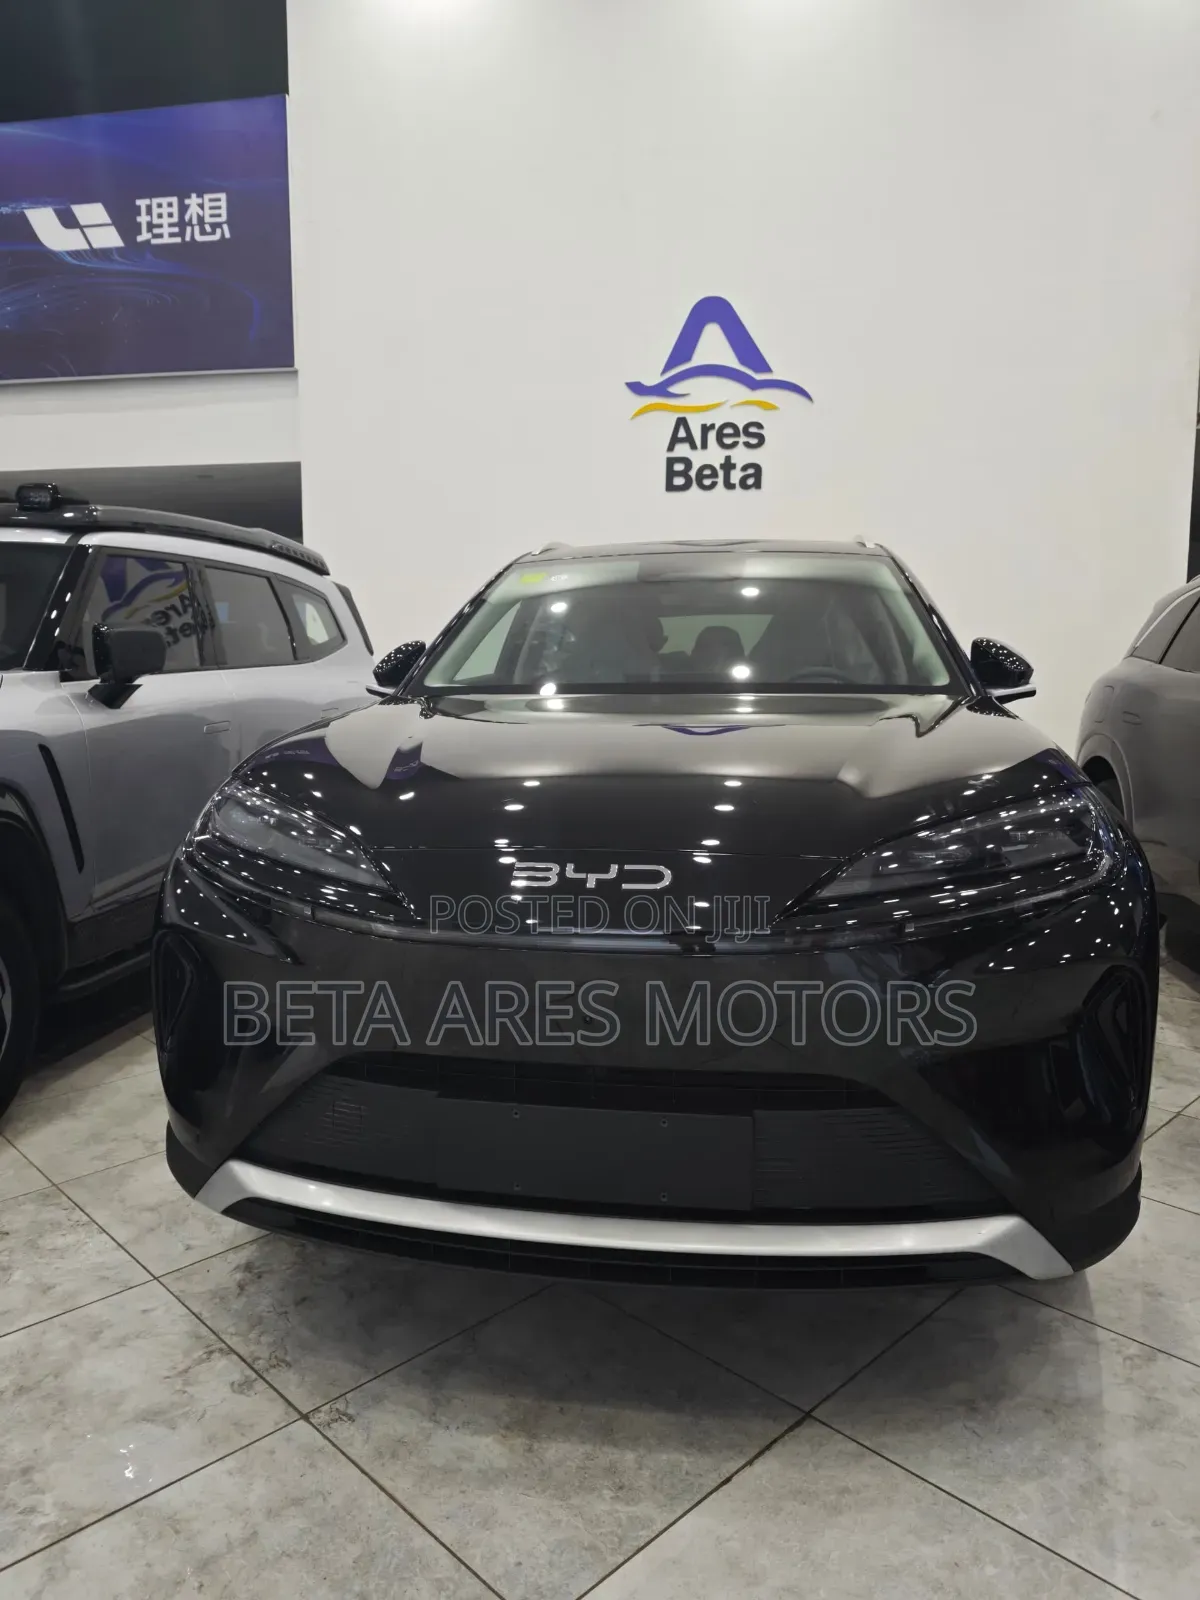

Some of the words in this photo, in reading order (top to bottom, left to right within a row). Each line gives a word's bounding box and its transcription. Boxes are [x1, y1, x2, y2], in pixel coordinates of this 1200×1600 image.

[135, 192, 231, 245] 理想
[666, 416, 766, 452] Ares
[665, 455, 763, 492] Beta
[511, 861, 672, 890] BYD
